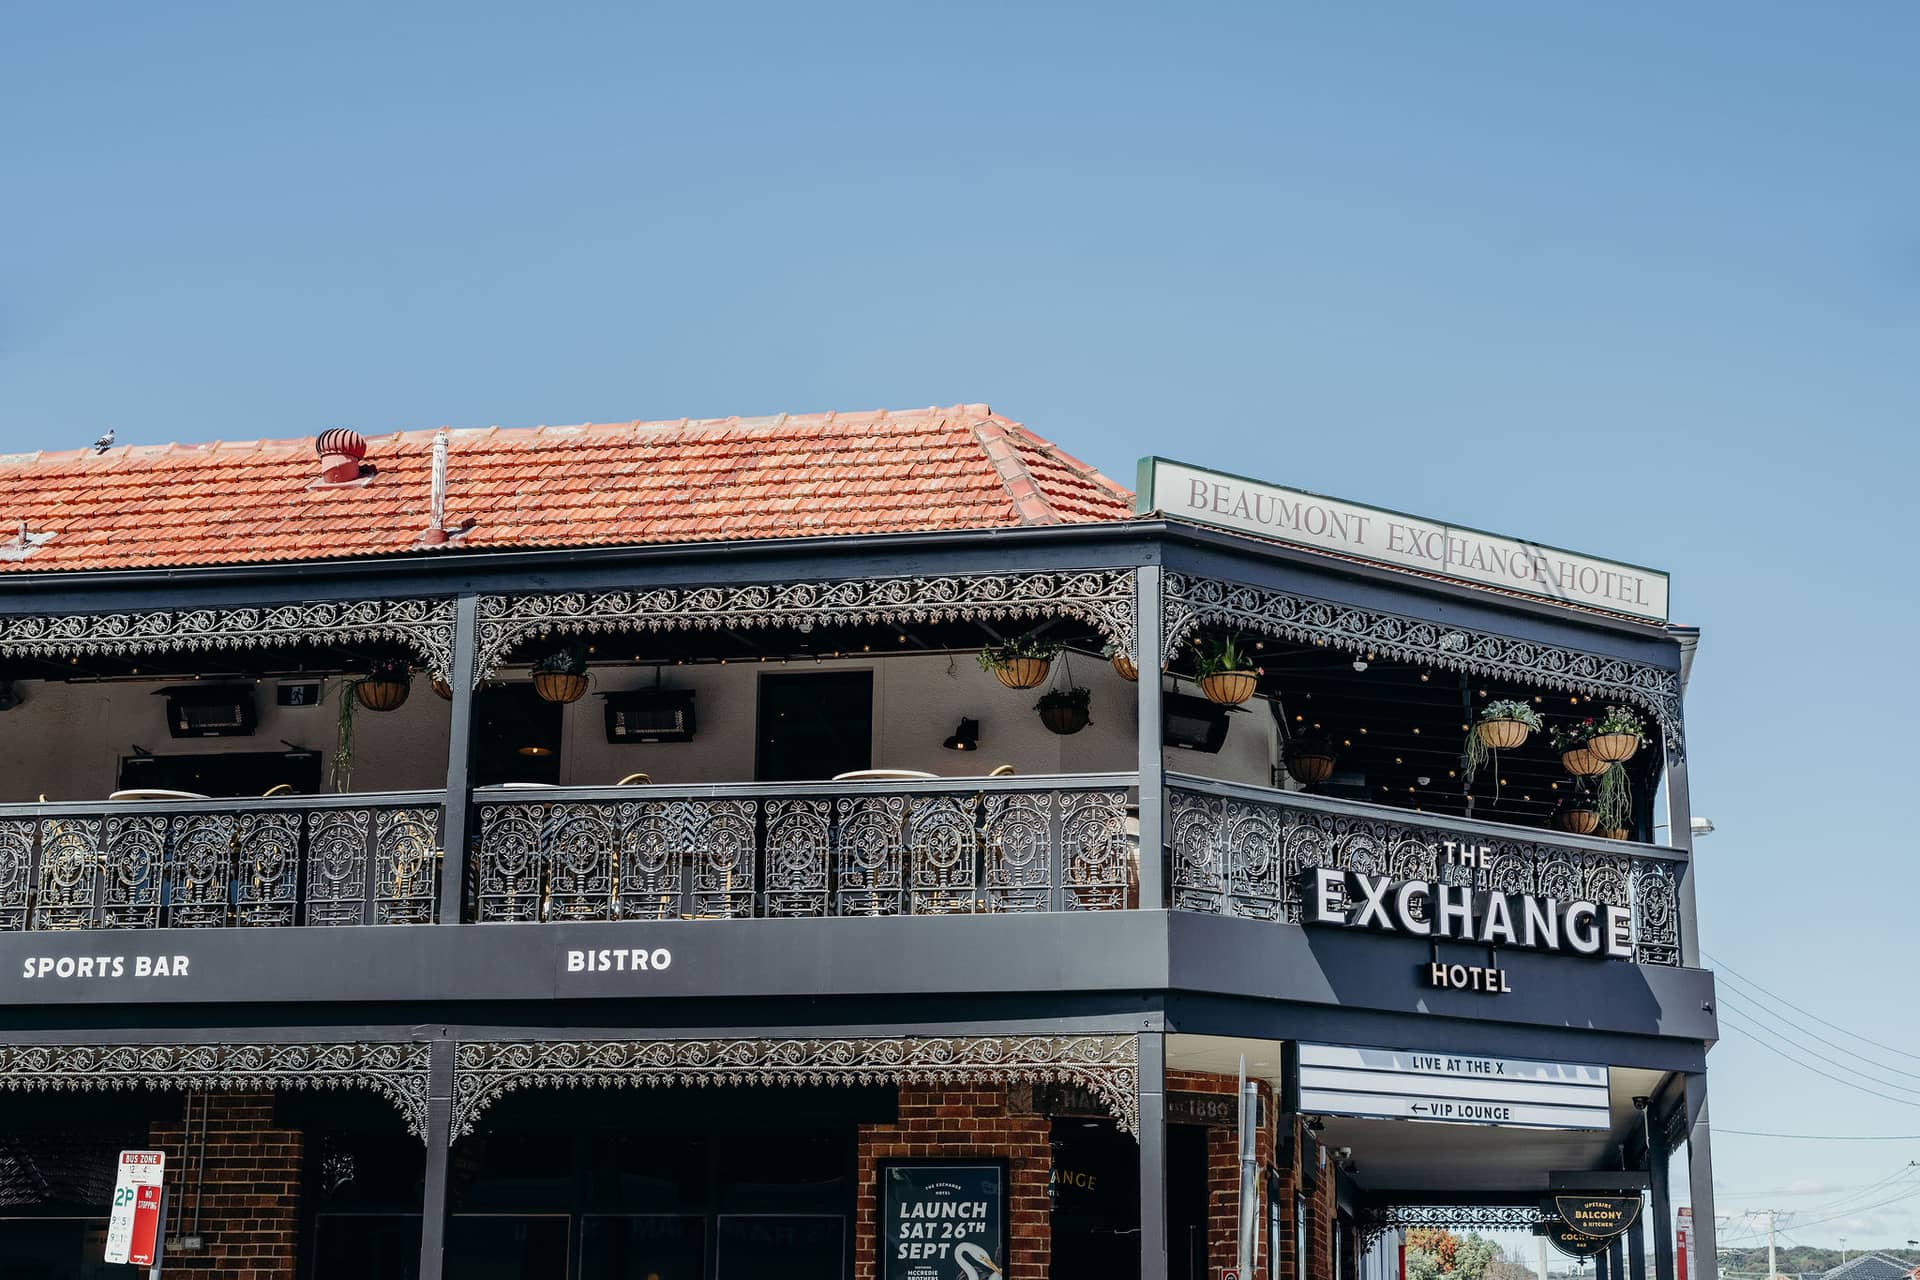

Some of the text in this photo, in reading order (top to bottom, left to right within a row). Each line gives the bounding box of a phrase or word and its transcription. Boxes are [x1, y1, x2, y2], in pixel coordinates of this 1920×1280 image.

[1187, 478, 1649, 606] BEAUMONT EXCHANGE HOTEL
[1444, 840, 1492, 869] THE
[1315, 867, 1631, 957] EXCHANGE
[23, 955, 190, 978] SPORTS BAR
[567, 948, 672, 972] BISTRO
[1431, 962, 1512, 993] HOTEL
[1413, 1056, 1504, 1075] LIVE AT THE X
[1431, 1103, 1510, 1120] VIP LOUNGE
[126, 1154, 158, 1164] BUS ZONE
[114, 1188, 134, 1207] 2P
[145, 1190, 152, 1199] NO
[899, 1202, 988, 1218] LAUNCH
[1575, 1211, 1622, 1220] BALCONY
[899, 1222, 986, 1239] SAT 26TH
[898, 1243, 951, 1260] SEPT
